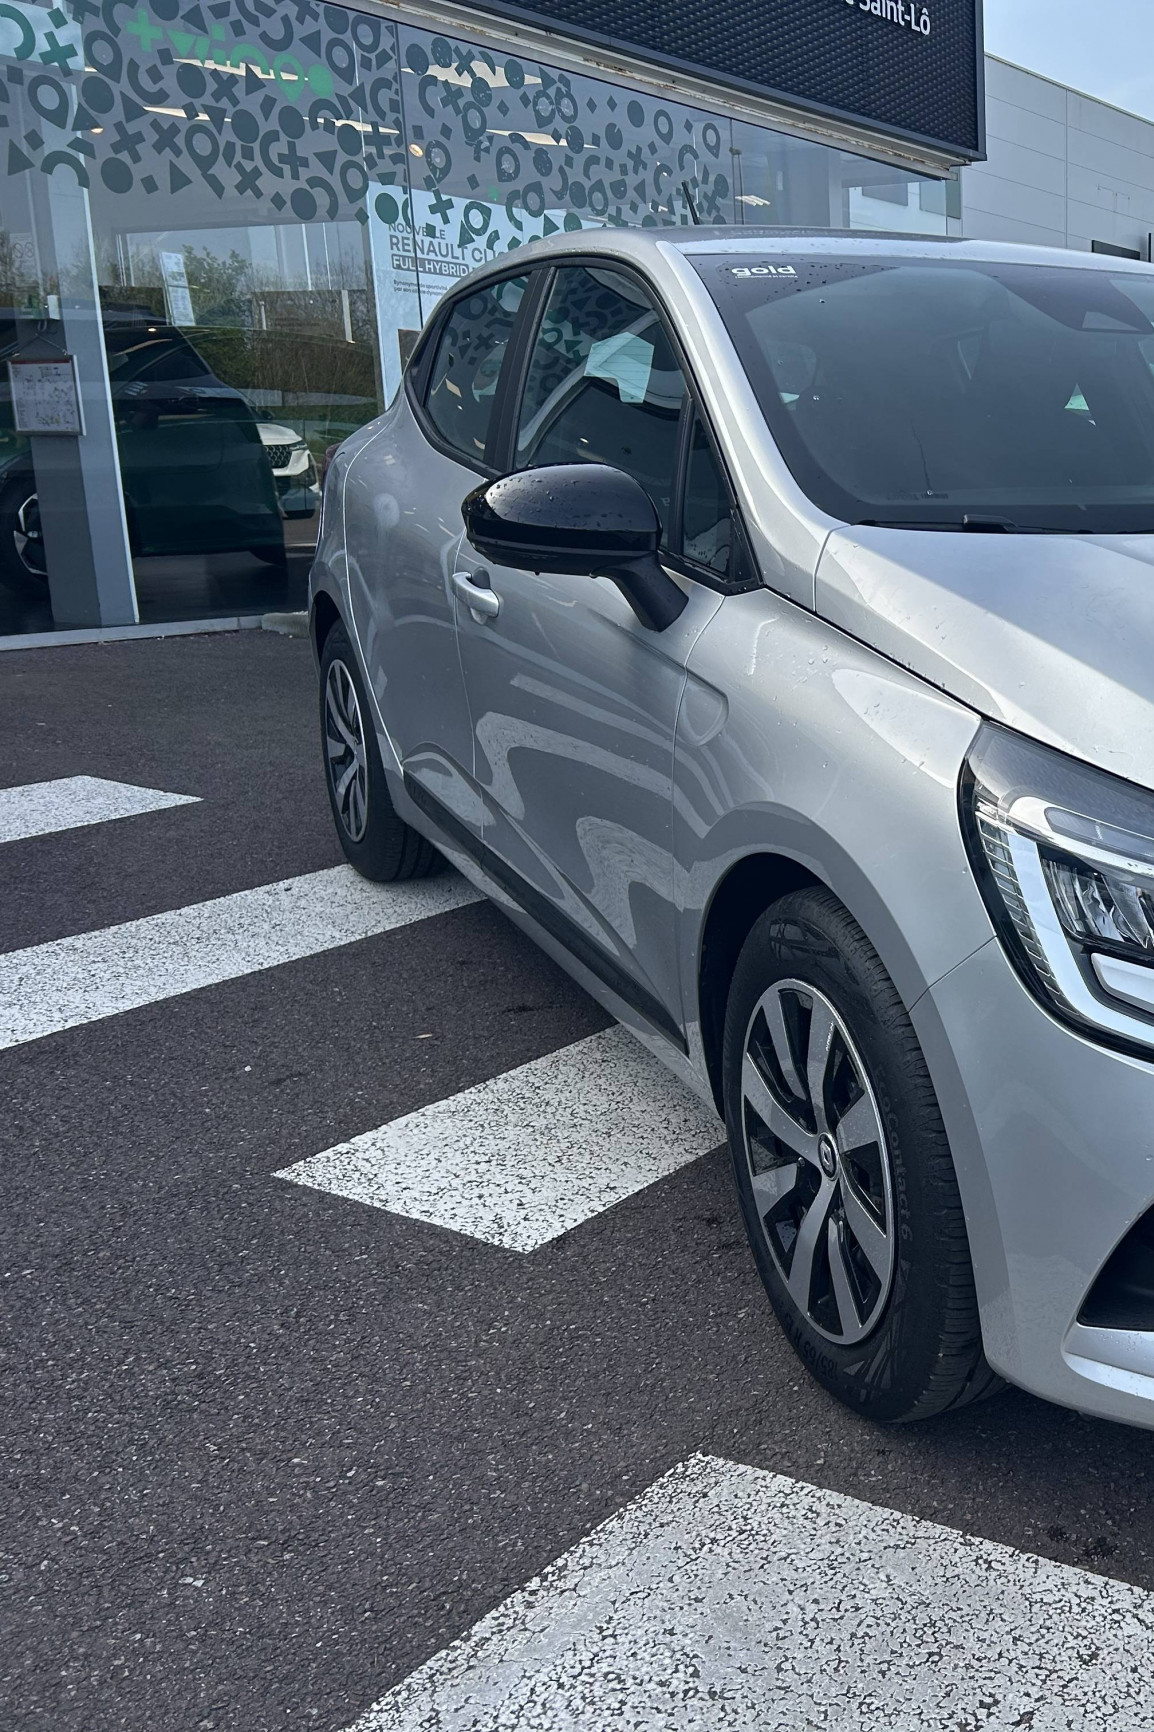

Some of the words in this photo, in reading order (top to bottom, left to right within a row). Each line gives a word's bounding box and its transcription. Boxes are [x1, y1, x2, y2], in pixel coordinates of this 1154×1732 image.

[389, 234, 469, 261] RENAULT
[392, 255, 424, 272] FULL
[425, 261, 470, 276] HYBRID
[731, 265, 796, 276] gold
